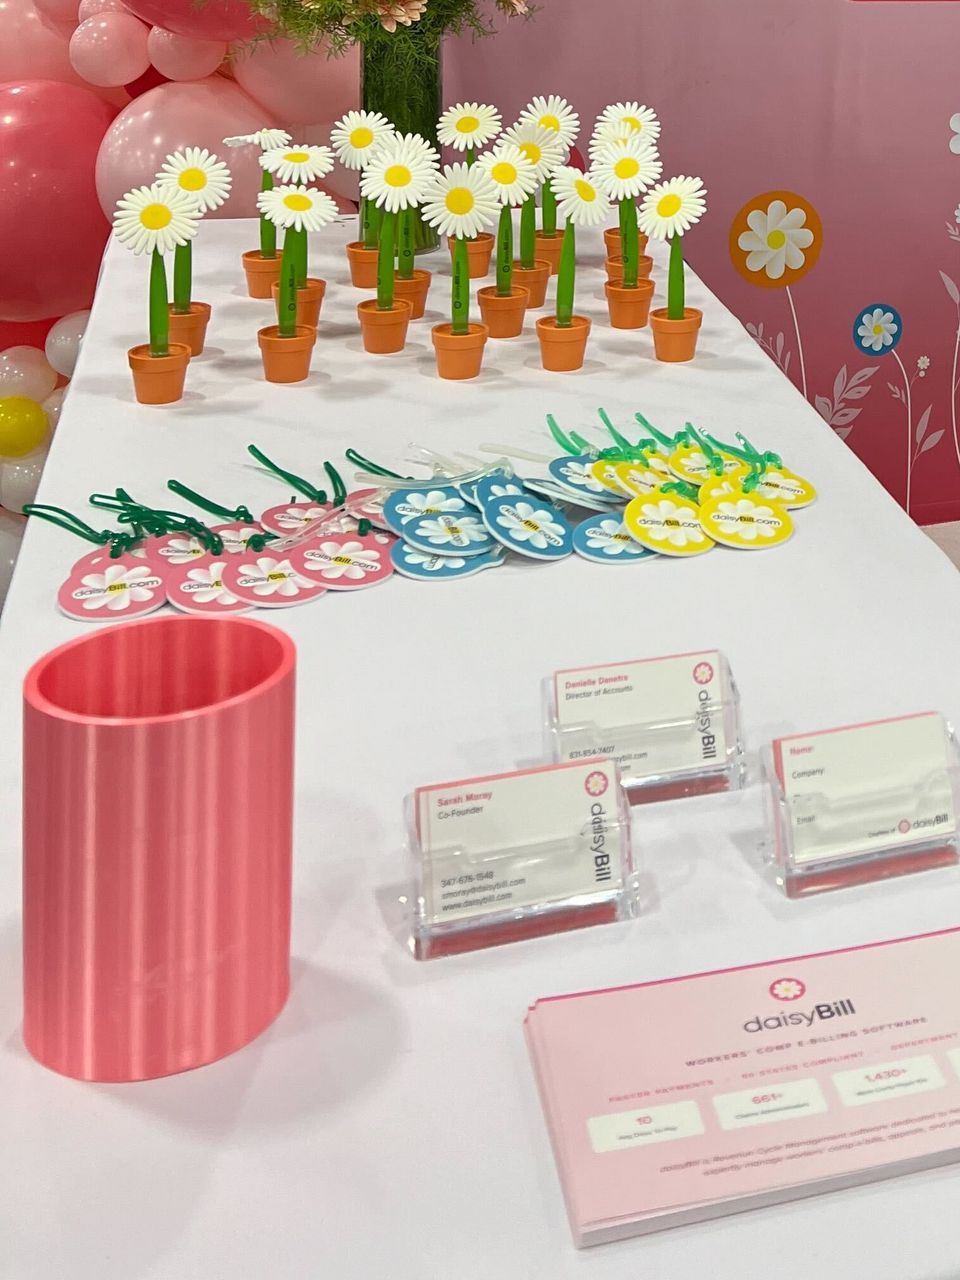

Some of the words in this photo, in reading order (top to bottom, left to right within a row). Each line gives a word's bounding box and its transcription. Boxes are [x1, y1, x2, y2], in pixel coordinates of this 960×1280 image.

[712, 513, 781, 526] daisyBill.com
[304, 551, 378, 570] daisyBill.com
[74, 578, 160, 598] daisyBill.com
[438, 806, 484, 820] Co-Founder
[590, 802, 612, 882] daisyBill
[743, 999, 856, 1033] daisyBill
[862, 1017, 927, 1035] SOFTWARE
